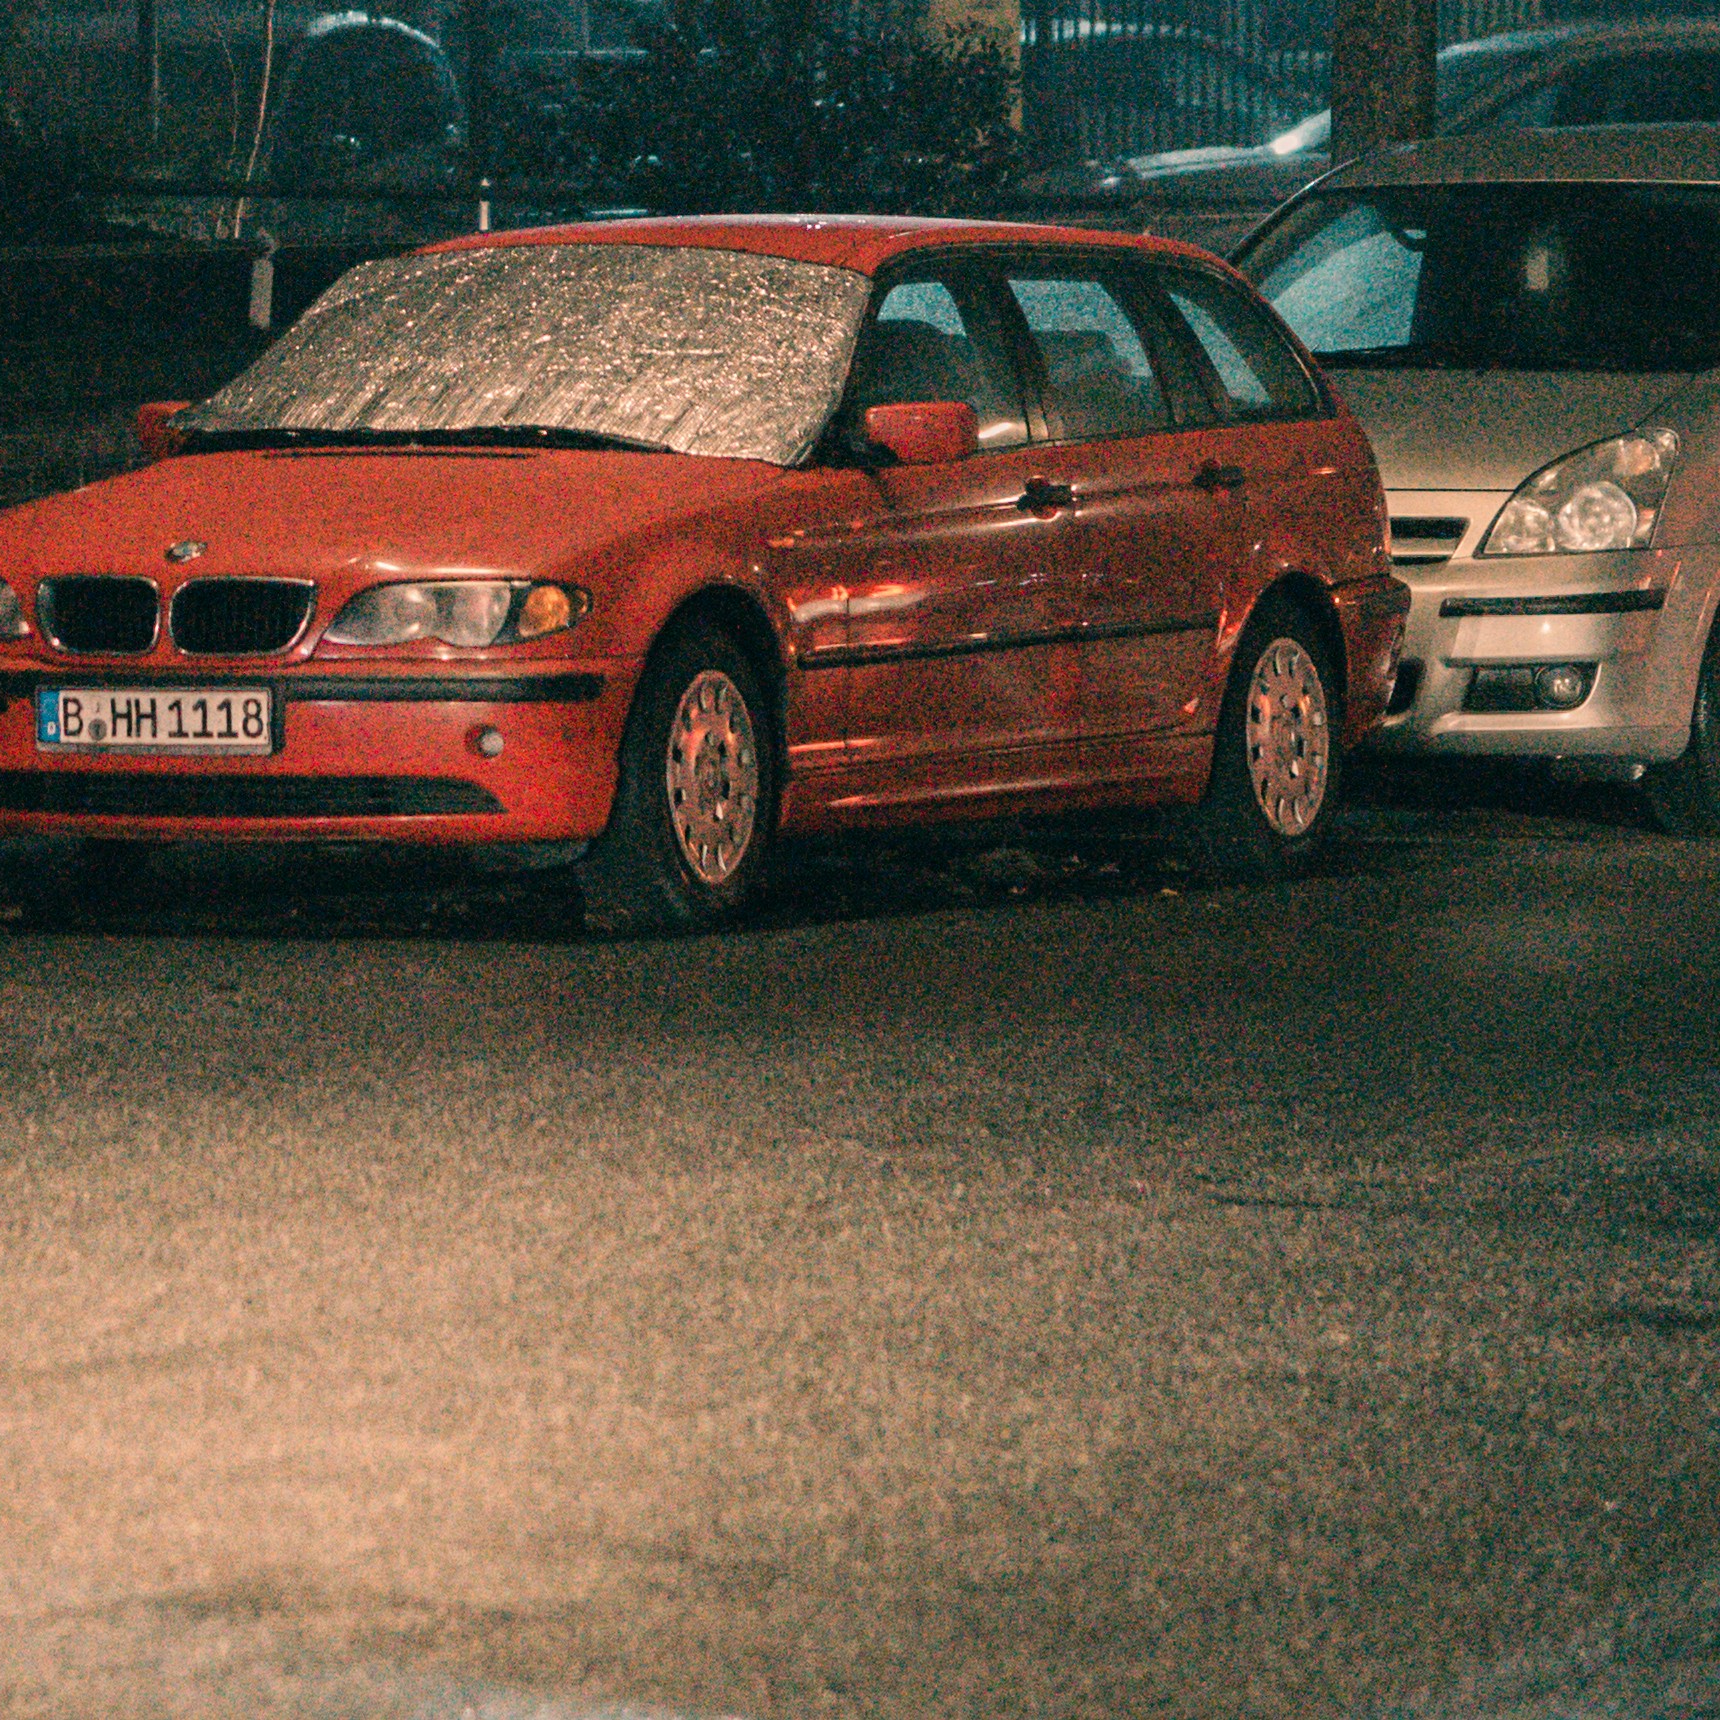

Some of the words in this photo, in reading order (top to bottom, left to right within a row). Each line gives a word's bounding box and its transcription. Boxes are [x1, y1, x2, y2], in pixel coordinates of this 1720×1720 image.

[63, 697, 84, 737] B
[110, 698, 158, 738] HH
[168, 698, 264, 738] 1118
